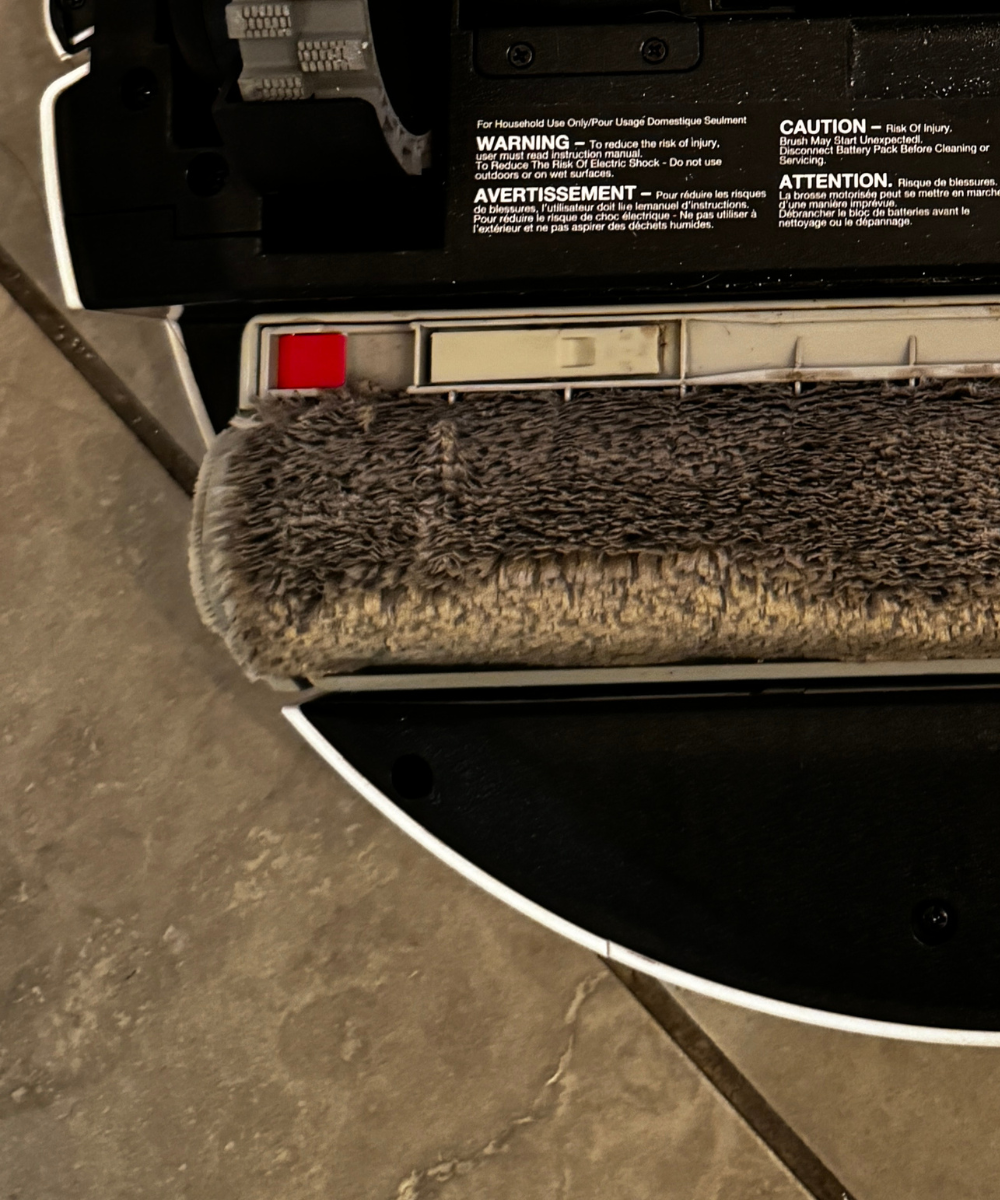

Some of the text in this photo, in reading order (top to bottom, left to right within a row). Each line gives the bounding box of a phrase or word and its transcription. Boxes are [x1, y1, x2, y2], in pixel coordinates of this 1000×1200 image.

[495, 120, 544, 128] Household
[567, 118, 613, 128] Only/Pour
[647, 117, 702, 127] Domestique
[704, 116, 746, 125] Seulment
[780, 118, 866, 135] CAUTION
[886, 124, 906, 133] Risk
[909, 124, 921, 132] Of
[476, 135, 570, 151] WARNING
[589, 141, 602, 149] To
[605, 140, 638, 148] reduce
[641, 140, 656, 148] the
[659, 139, 676, 148] risk
[678, 139, 688, 148] of
[780, 137, 808, 146] Brush
[811, 137, 831, 147] May
[834, 136, 857, 145] Start
[527, 151, 548, 159] read
[552, 150, 602, 159] instruction
[605, 150, 642, 158] manual.
[780, 146, 833, 155] Disconnect
[836, 146, 871, 156] Battery
[874, 145, 897, 154] Pack
[901, 144, 932, 153] Before
[935, 144, 977, 154] Cleaning
[476, 162, 488, 170] To
[491, 161, 528, 169] Reduce
[531, 160, 549, 169] The
[552, 160, 573, 168] Risk
[576, 160, 588, 168] Of
[590, 159, 626, 168] Electric
[629, 159, 659, 167] Shock
[670, 159, 684, 167] Do
[779, 156, 826, 166] Servicing.
[474, 171, 519, 180] outdoors
[570, 170, 614, 178] surfaces.
[779, 173, 998, 189] ATTENTION. Risque de blessures.
[474, 185, 766, 203] AVERTISSEMENT Pour réduire les risques
[779, 192, 791, 200] La
[794, 191, 826, 200] brosse
[880, 191, 901, 200] peut
[474, 205, 486, 213] de
[597, 203, 615, 211] doit
[779, 200, 806, 208] d'une
[809, 199, 847, 208] manière
[474, 210, 757, 224] Pour réduire le risque de choc électrique Ne pas utiliser à
[779, 209, 835, 218] Débrancher
[838, 209, 846, 217] le
[872, 208, 885, 217] de
[888, 208, 930, 216] batteries
[962, 207, 970, 215] le
[473, 224, 521, 232] l'extérieur
[551, 225, 569, 233] pas
[572, 222, 605, 233] aspirer
[608, 222, 626, 230] des
[628, 221, 667, 230] déchets
[670, 220, 714, 229] humides.
[778, 219, 826, 229] nettoyage
[845, 218, 853, 226] le
[856, 217, 912, 227] dépannage.
